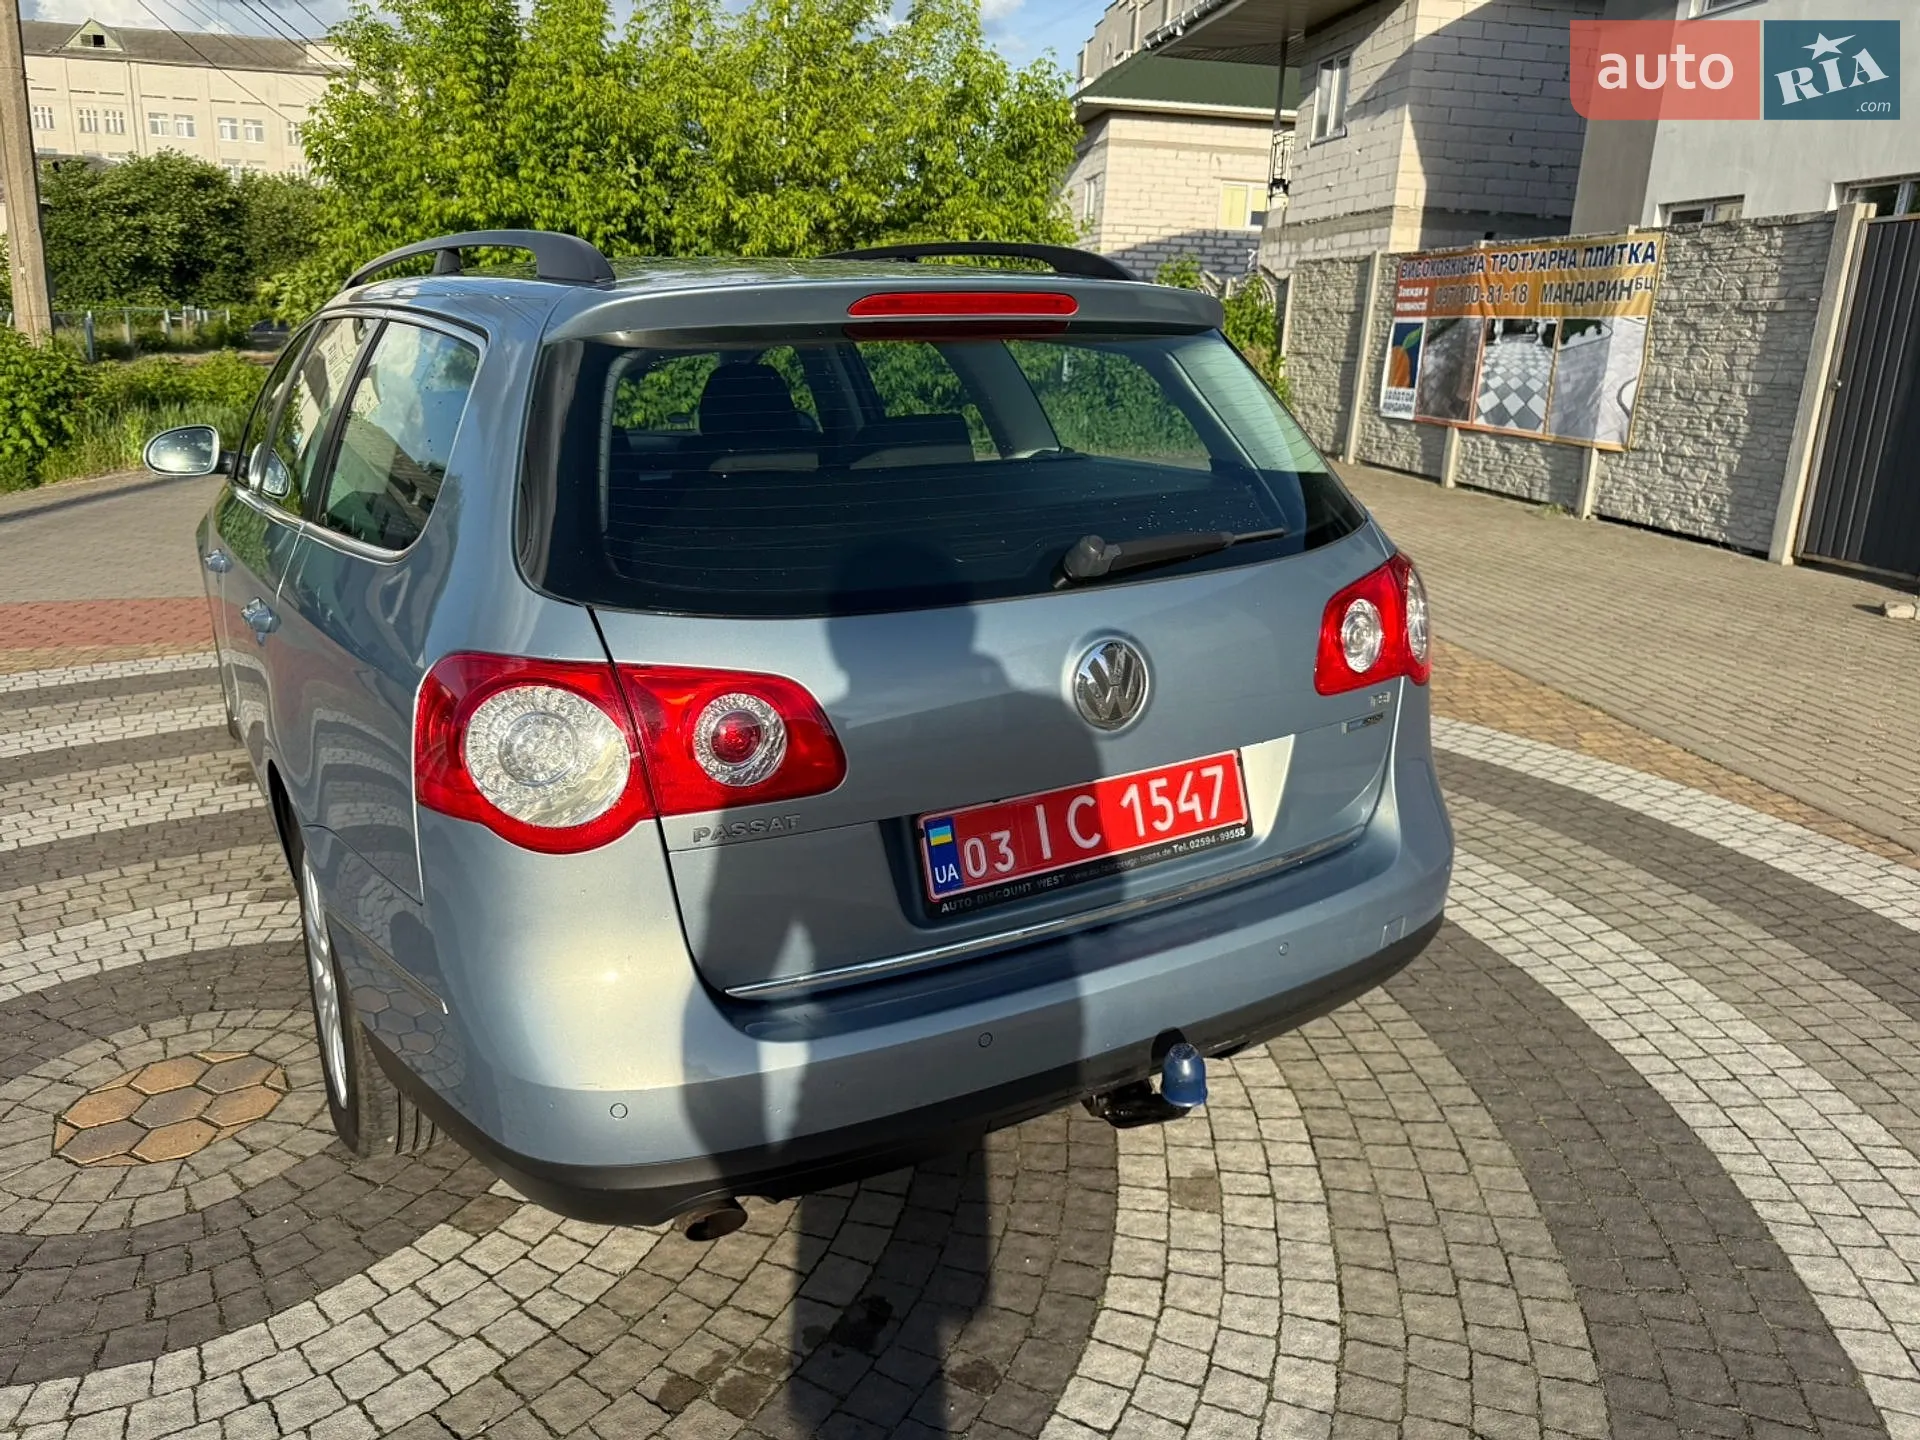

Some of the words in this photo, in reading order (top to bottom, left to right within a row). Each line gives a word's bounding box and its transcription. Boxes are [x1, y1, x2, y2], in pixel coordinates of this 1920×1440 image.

[1400, 252, 1486, 280] ВИСОКОЯКІСНА
[1490, 247, 1577, 274] ТРОТУАРНА
[1582, 240, 1656, 268] ПЛИТКА
[1541, 278, 1634, 306] МАНДАРИН
[692, 814, 801, 843] PASSAT
[963, 830, 1015, 879] 03
[1120, 764, 1224, 838] 1547
[934, 863, 959, 884] UA
[941, 897, 972, 913] AUTO
[977, 883, 1033, 903] DISCOUNT
[1036, 874, 1066, 888] WEST
